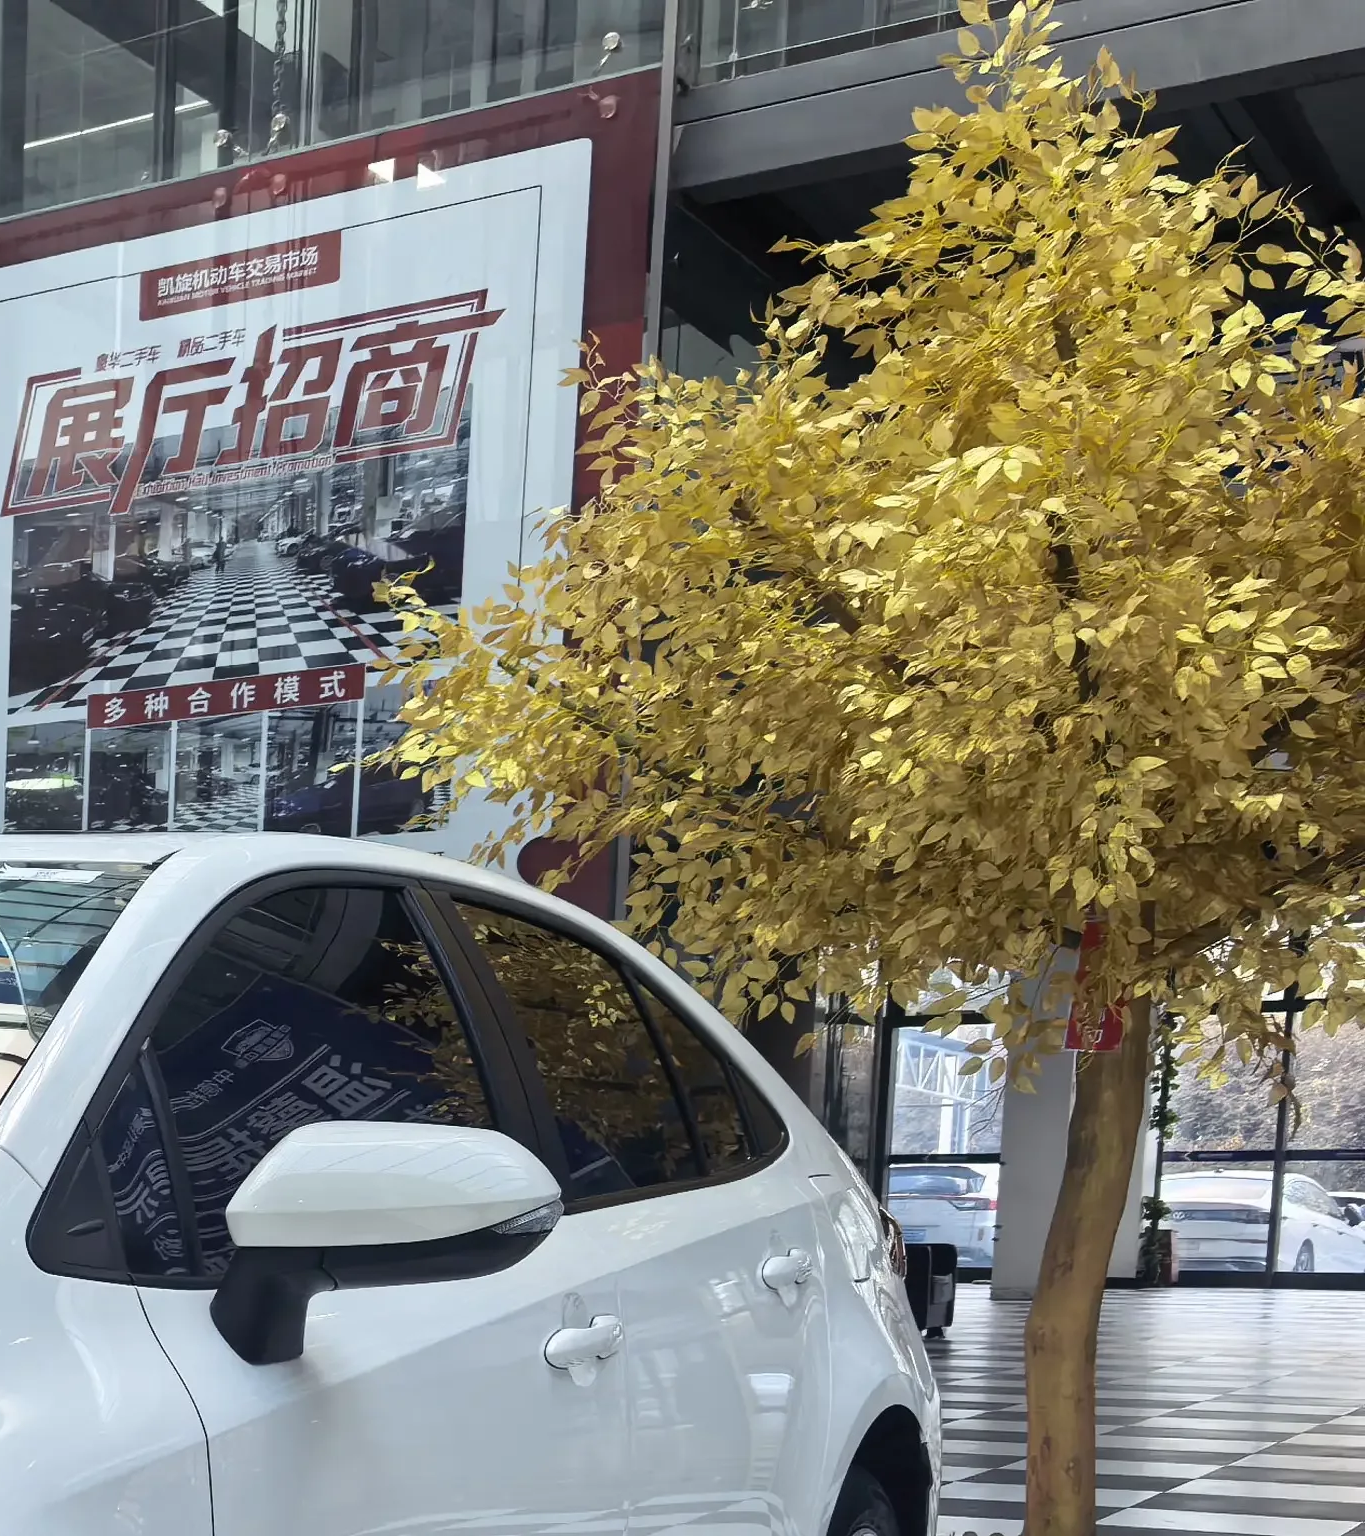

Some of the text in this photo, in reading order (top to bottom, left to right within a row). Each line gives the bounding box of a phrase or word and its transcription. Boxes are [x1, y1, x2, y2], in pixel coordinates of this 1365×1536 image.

[157, 245, 319, 298] 凯旋机动车交易市场
[24, 308, 506, 517] 展厅招商
[103, 672, 347, 726] 多种合作模式
